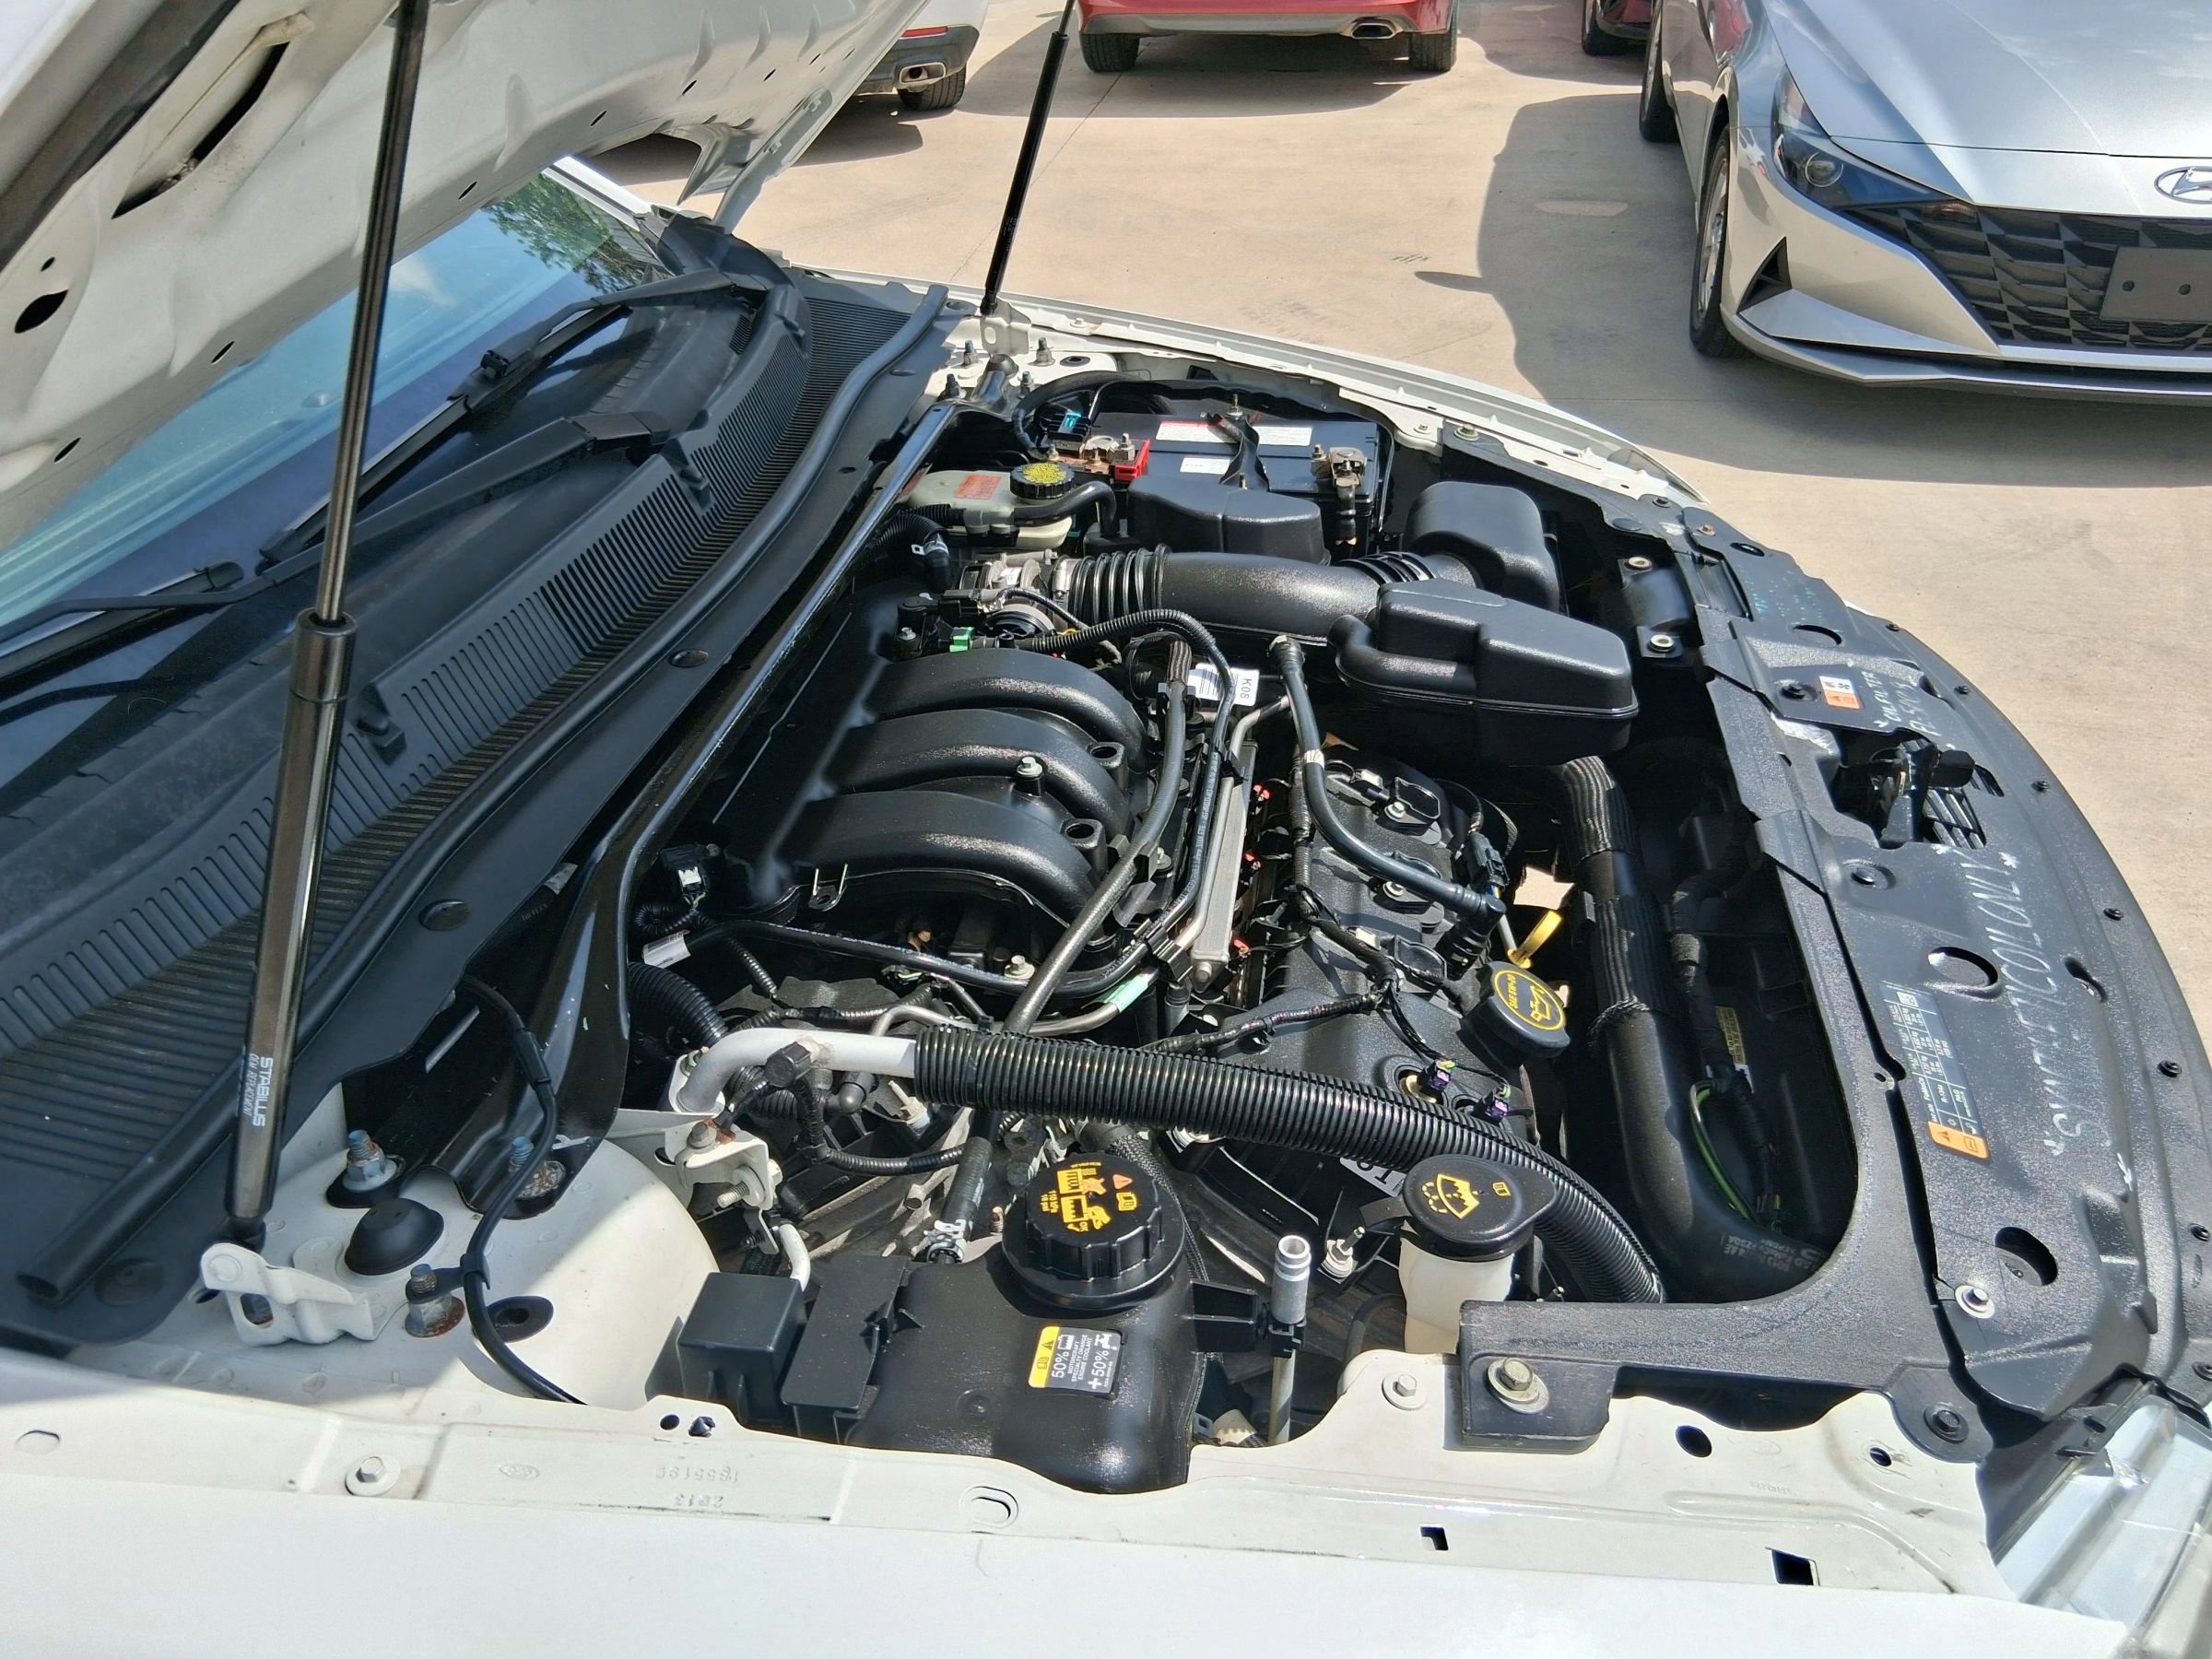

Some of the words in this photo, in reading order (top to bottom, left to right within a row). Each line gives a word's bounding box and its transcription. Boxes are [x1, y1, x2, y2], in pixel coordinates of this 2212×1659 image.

[1241, 677, 1253, 700] K08
[253, 1056, 274, 1127] STABILUS
[1079, 1221, 1088, 1231] OK
[1052, 1351, 1070, 1378] 50%
[1067, 1341, 1080, 1374] MOTORCRAFT
[1071, 1354, 1082, 1382] SPECIALTY
[1077, 1334, 1088, 1355] ORANGE
